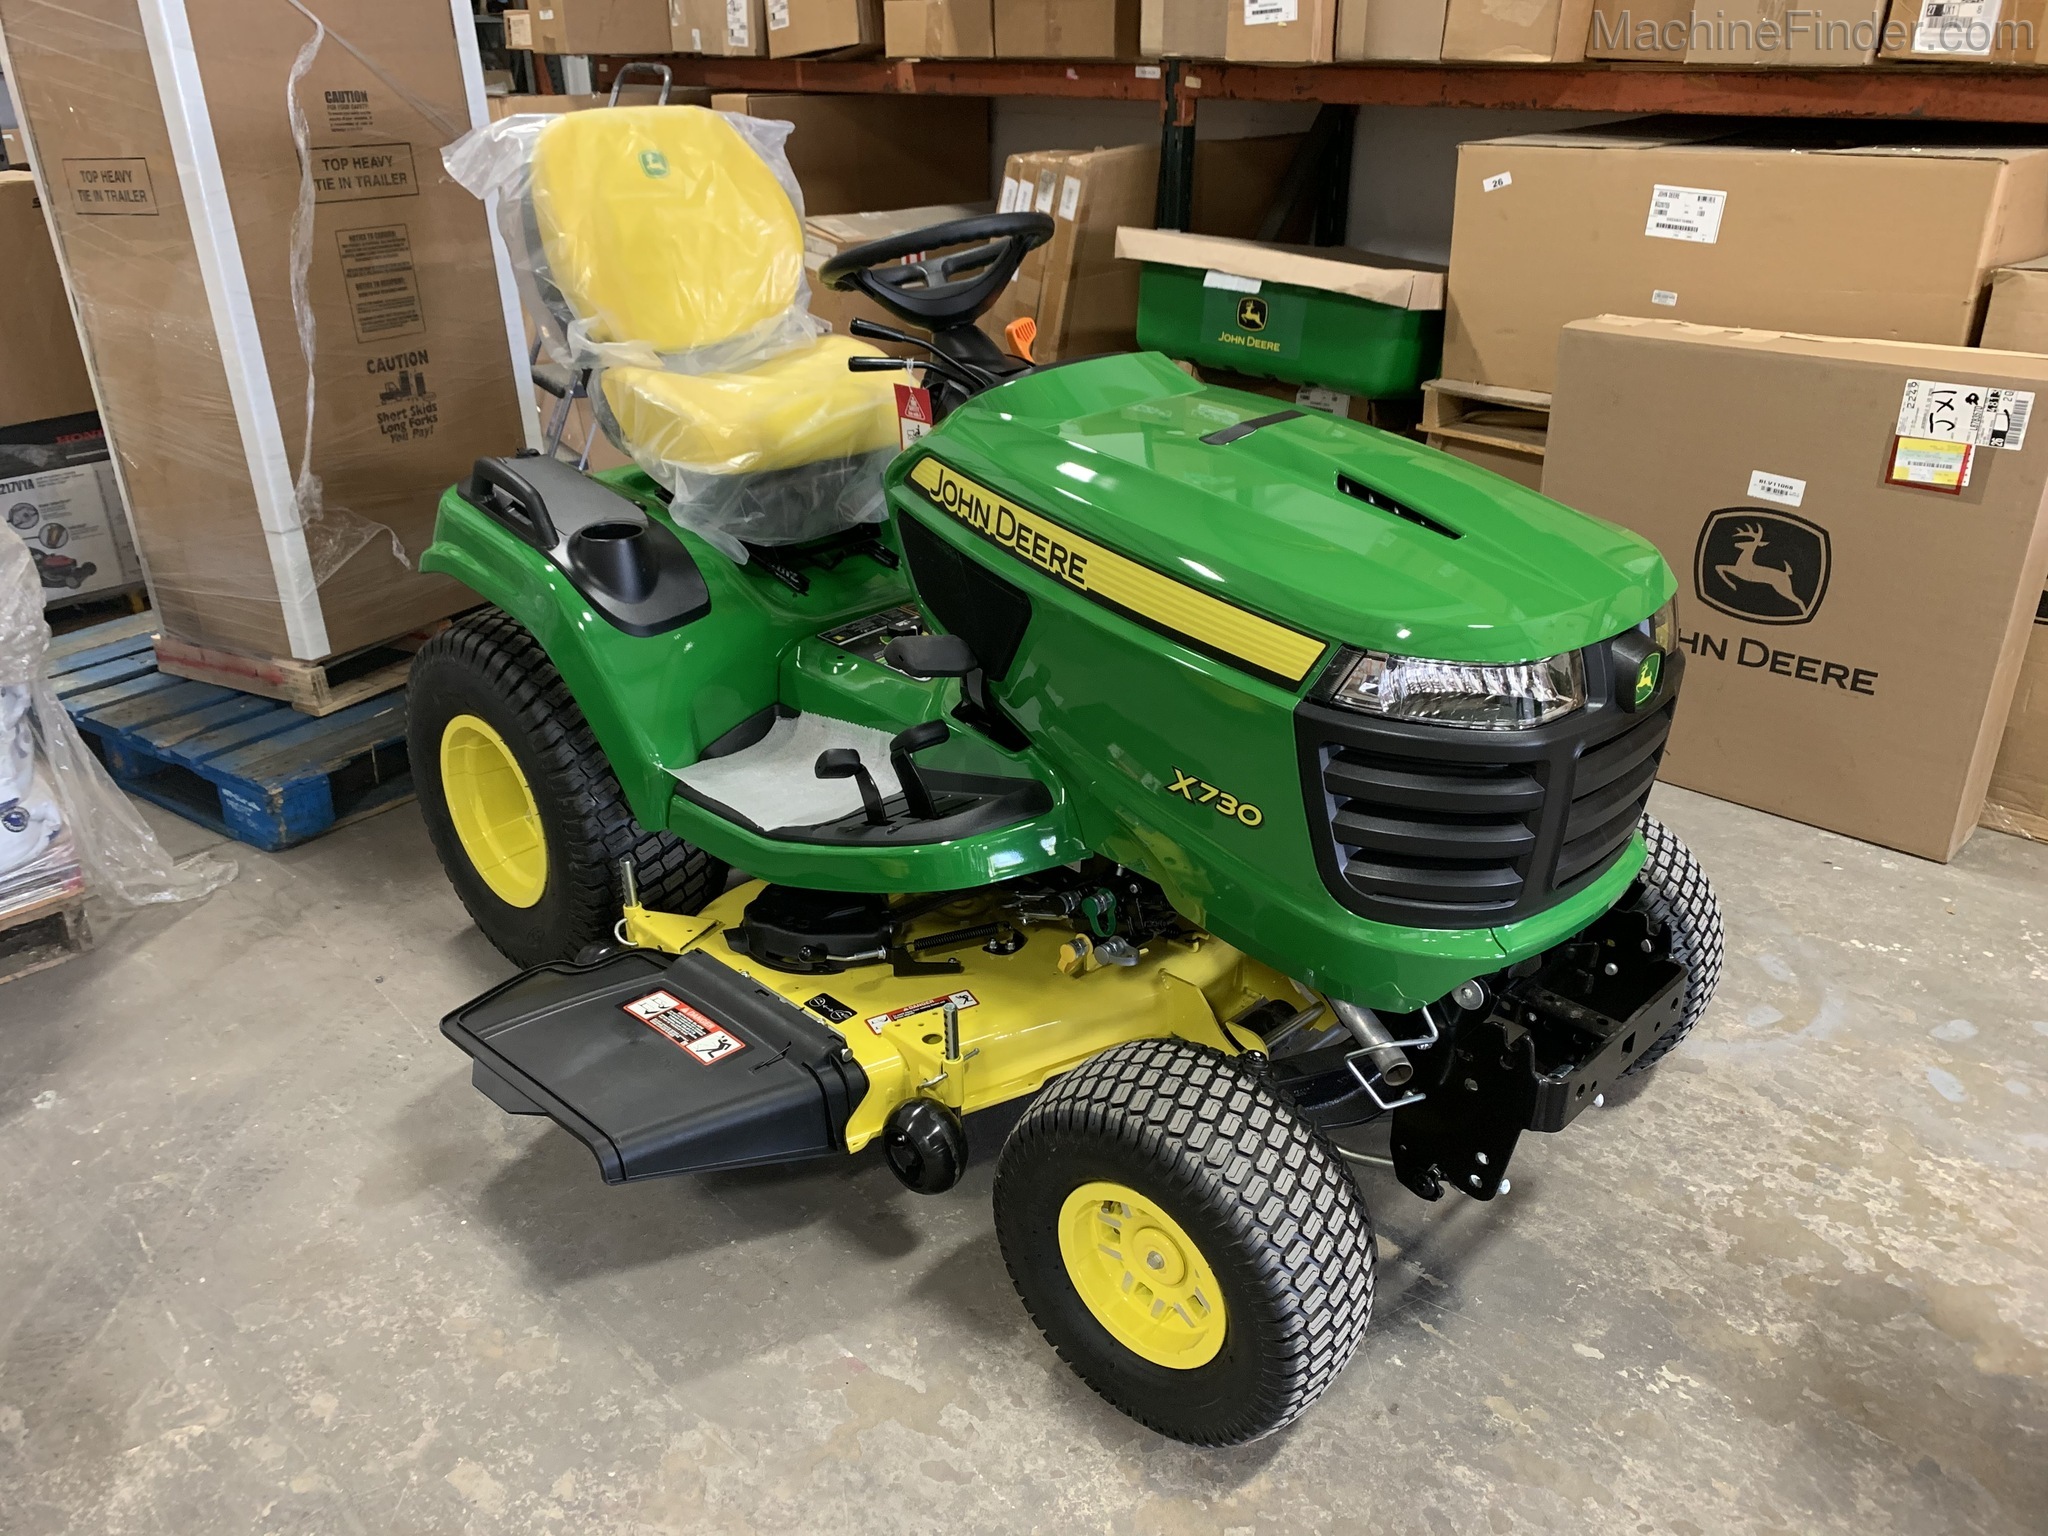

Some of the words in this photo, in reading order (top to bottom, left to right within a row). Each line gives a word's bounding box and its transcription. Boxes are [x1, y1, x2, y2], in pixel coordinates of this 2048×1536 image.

[324, 90, 369, 104] CAUTION
[322, 158, 348, 171] TOP
[352, 155, 393, 170] HEAVY
[79, 170, 99, 183] TOP
[101, 170, 132, 183] HEAVY
[313, 177, 336, 192] TIE
[338, 177, 352, 190] IN
[355, 172, 408, 188] TRAILER
[1492, 177, 1504, 188] 26
[77, 189, 92, 203] TIE
[92, 189, 104, 202] IN
[104, 190, 148, 203] TRAILER
[1218, 331, 1246, 346] JOHN
[1246, 335, 1280, 352] DEERE
[366, 348, 429, 374] CAUTION
[1906, 381, 1919, 409] 2249
[377, 408, 407, 424] Short
[410, 402, 438, 417] Skids
[380, 421, 408, 435] Long
[409, 413, 438, 428] Forks
[55, 427, 104, 446] HON
[1990, 437, 2004, 447] 26
[930, 468, 991, 533] JOHN
[996, 505, 1088, 588] DEERE
[1679, 628, 1729, 661] HN
[1737, 637, 1879, 696] DEERE
[1165, 766, 1264, 828] X730
